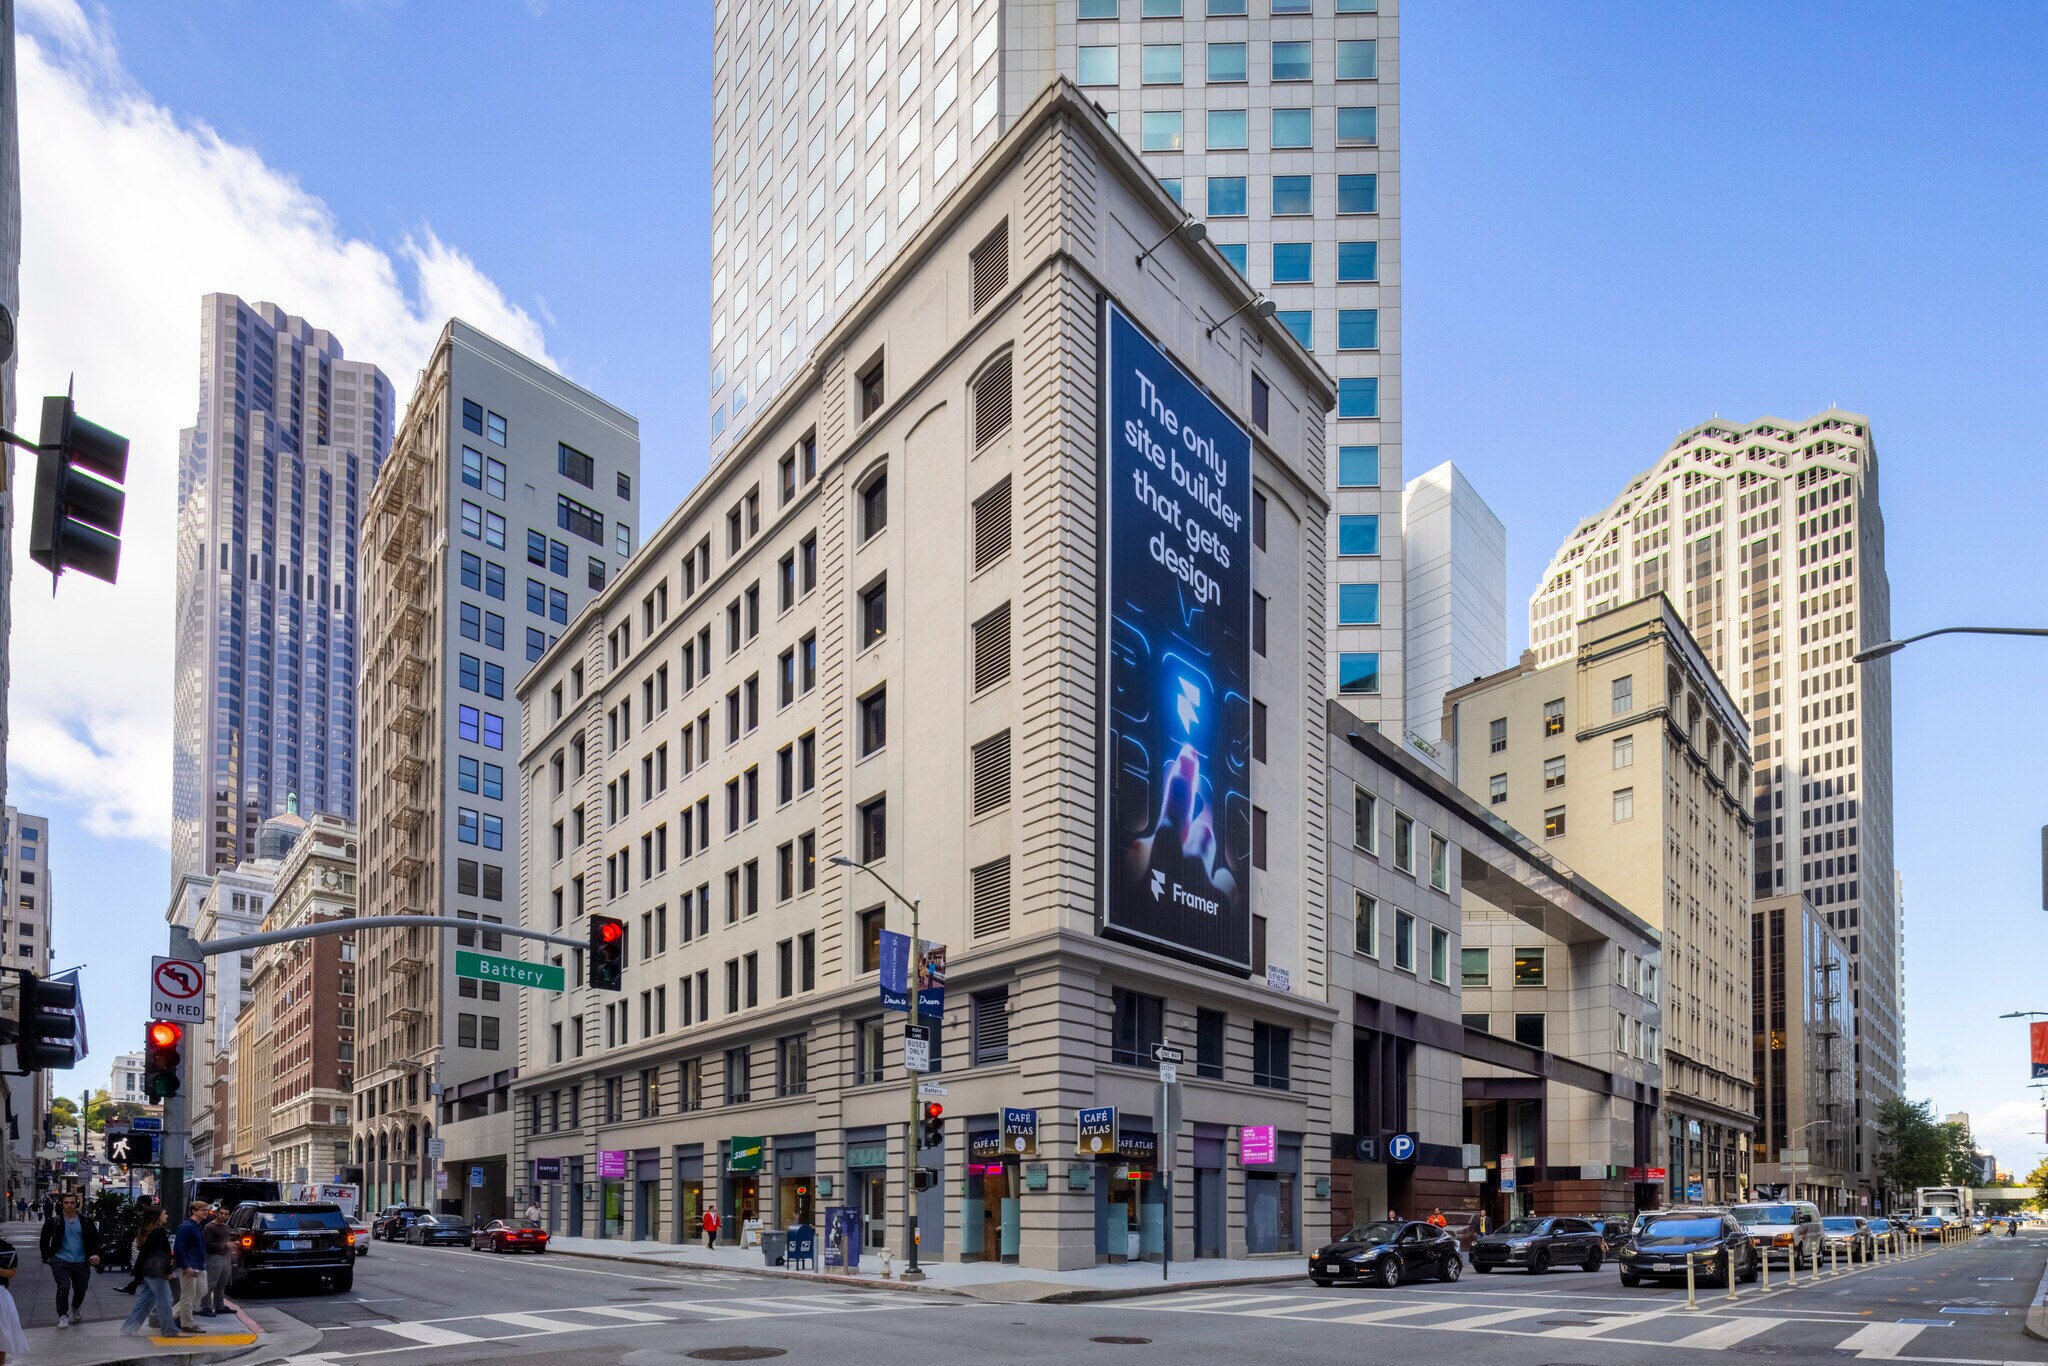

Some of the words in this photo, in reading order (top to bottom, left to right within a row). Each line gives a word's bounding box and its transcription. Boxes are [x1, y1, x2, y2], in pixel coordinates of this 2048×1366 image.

[1134, 368, 1178, 435] The
[1183, 426, 1226, 487] only
[1125, 418, 1166, 470] site
[1171, 448, 1242, 533] builder
[1132, 468, 1182, 532] that
[1186, 518, 1230, 568] gets
[1150, 531, 1220, 606] design
[1173, 882, 1218, 915] Framer
[480, 960, 543, 985] Battery
[884, 994, 900, 1004] Down
[919, 995, 940, 1005] Dream
[155, 1002, 171, 1013] ON
[177, 1004, 200, 1016] RED
[908, 1040, 926, 1048] BUSES
[1009, 1113, 1031, 1122] CAFÉ
[1084, 1111, 1107, 1122] CAFÉ
[1006, 1125, 1033, 1135] ATLAS
[1082, 1125, 1110, 1135] ATLAS
[974, 1139, 988, 1148] CAFÉ
[1135, 1141, 1153, 1149] ATLAS
[1396, 1138, 1410, 1156] P
[734, 1146, 761, 1160] SUBWAY
[324, 1189, 352, 1198] FedEx
